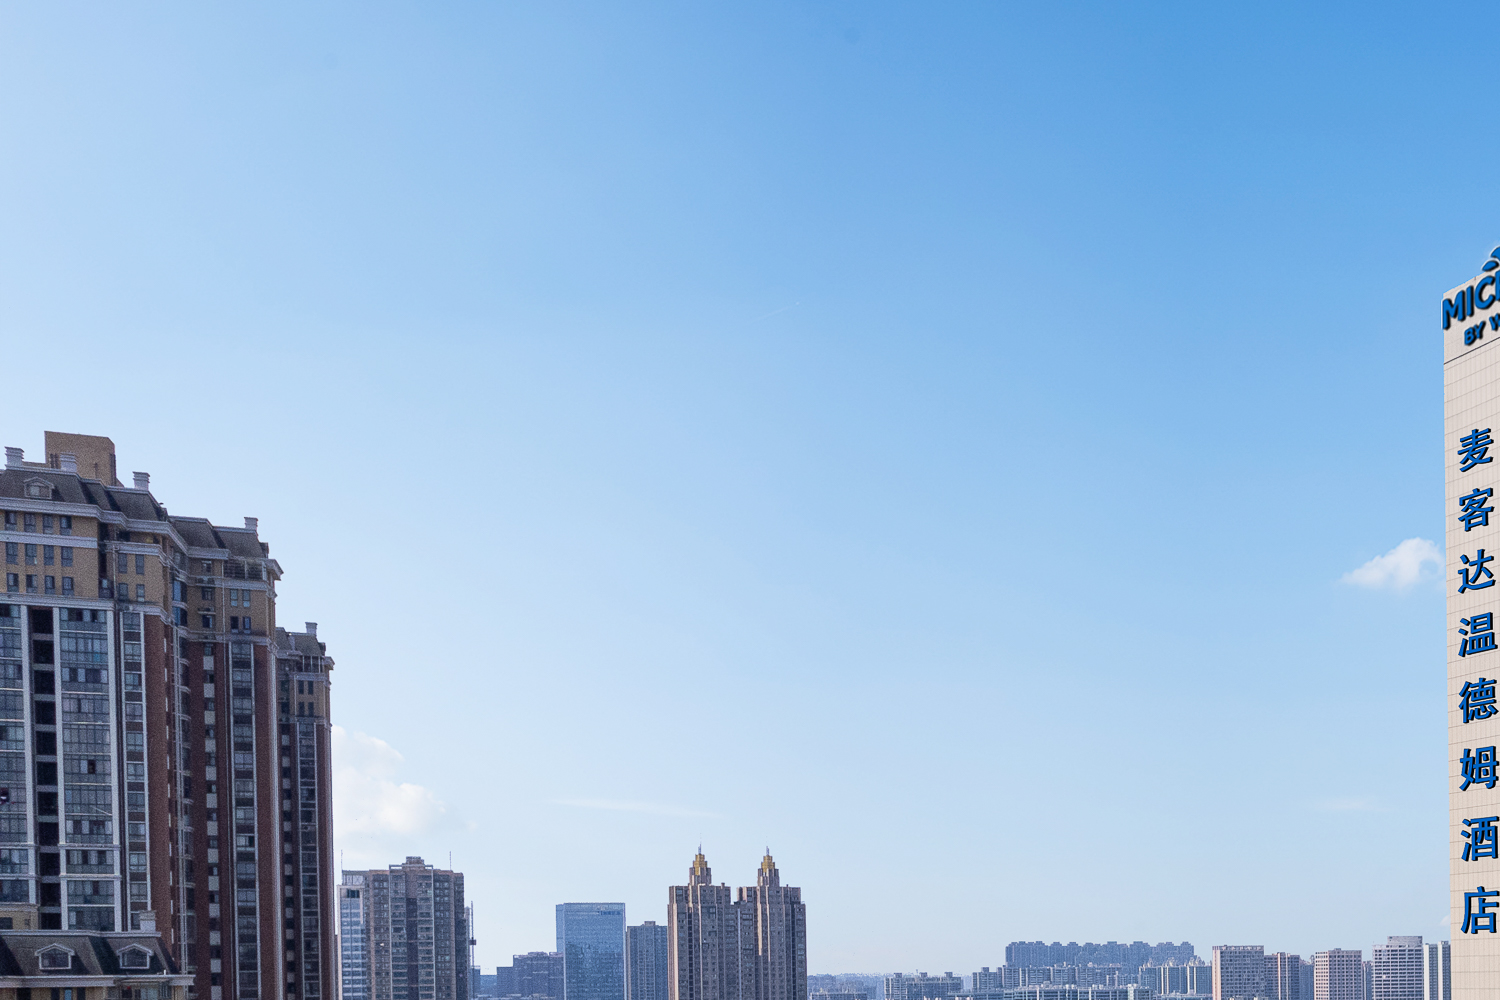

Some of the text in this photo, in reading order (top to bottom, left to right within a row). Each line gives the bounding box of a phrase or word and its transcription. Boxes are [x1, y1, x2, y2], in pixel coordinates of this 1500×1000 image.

[1464, 321, 1486, 346] BY
[1456, 428, 1500, 935] 麦客达温德姆酒店
